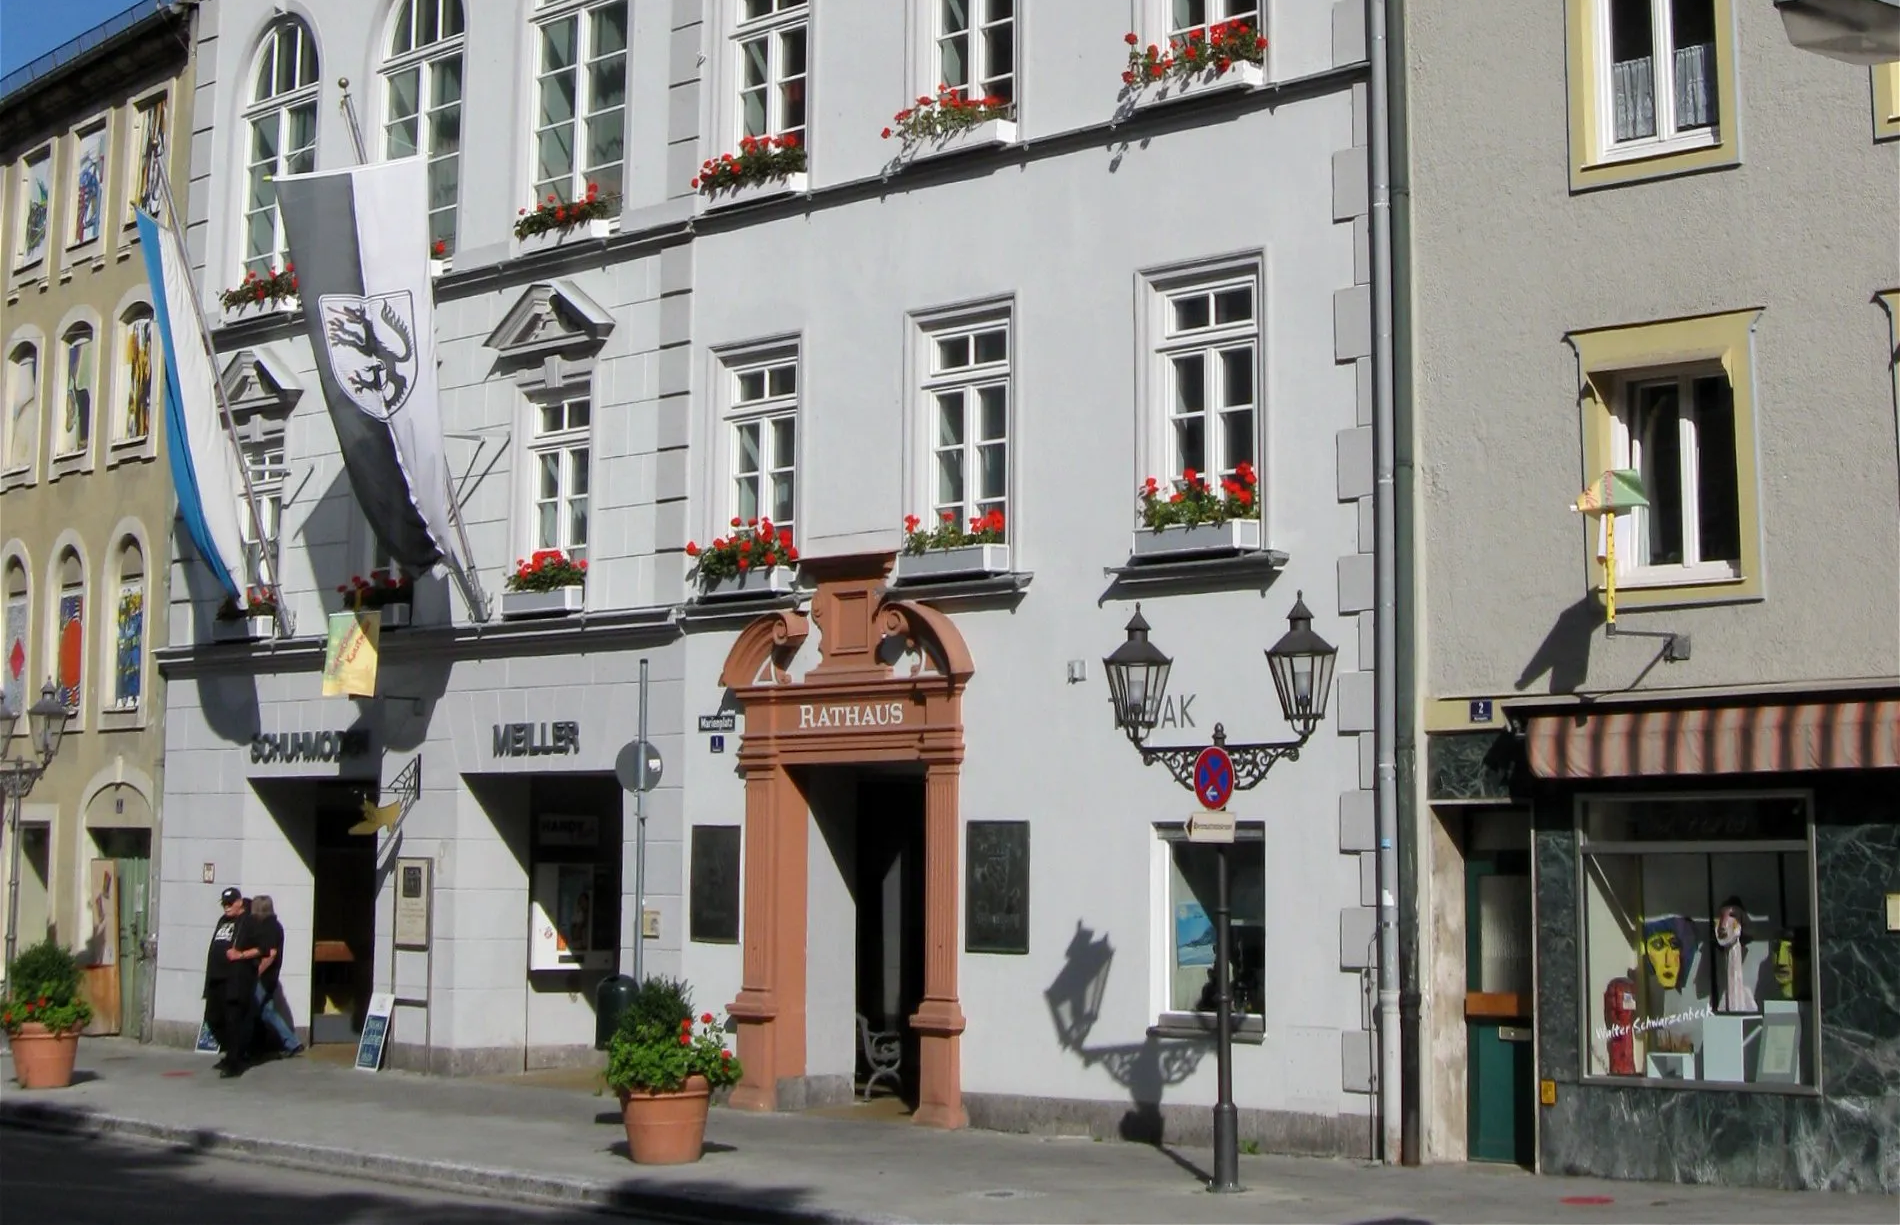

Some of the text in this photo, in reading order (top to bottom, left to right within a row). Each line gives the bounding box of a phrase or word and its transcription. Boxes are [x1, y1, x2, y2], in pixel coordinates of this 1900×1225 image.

[799, 703, 903, 728] RATHAUS
[1478, 701, 1484, 714] 2
[700, 716, 733, 732] Marienplatz
[493, 721, 579, 758] MEILLER
[1596, 1003, 1715, 1040] Walter Schwarzenbeck
